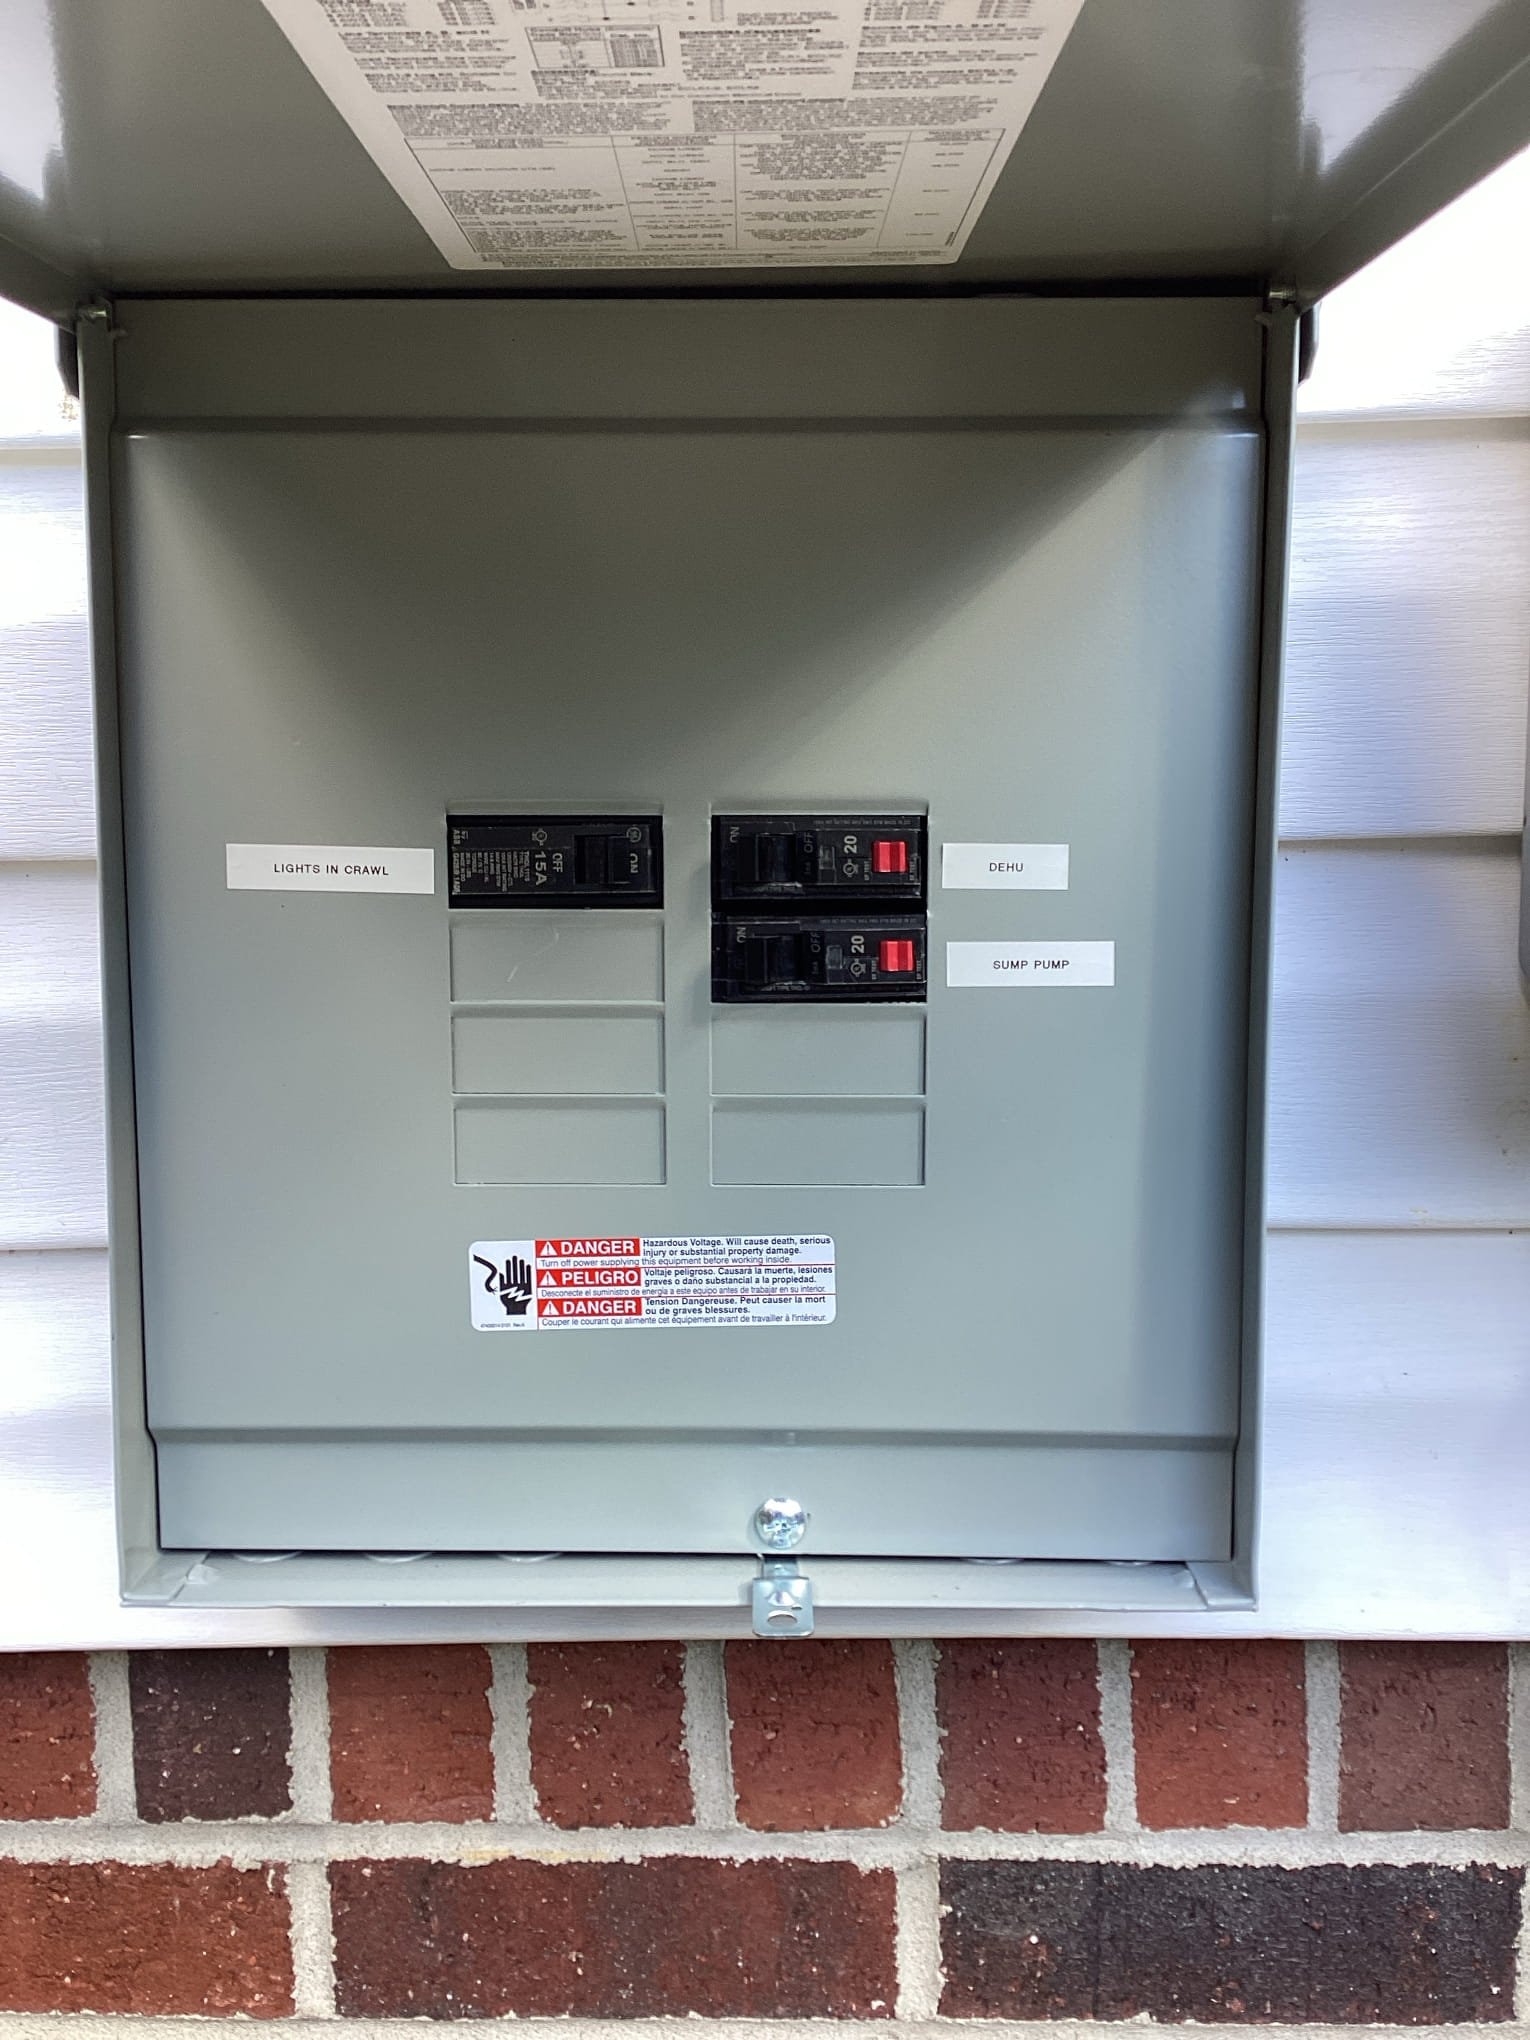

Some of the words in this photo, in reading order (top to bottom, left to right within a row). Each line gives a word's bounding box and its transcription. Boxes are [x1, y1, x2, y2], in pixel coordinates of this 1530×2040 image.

[804, 832, 813, 853] OFF
[844, 835, 858, 854] 20
[534, 851, 547, 886] 15A
[552, 852, 564, 873] OFF
[989, 862, 1024, 872] DEHU
[274, 864, 320, 873] LIGHTS
[326, 865, 339, 874] IN
[344, 865, 389, 875] CRAWL
[851, 935, 865, 954] 20
[993, 960, 1028, 970] SUMP
[1034, 960, 1070, 969] PUMP
[560, 1241, 634, 1254] DANGER
[643, 1239, 688, 1247] Hazardous
[690, 1238, 723, 1248] Voltage.
[772, 1237, 797, 1246] death,
[643, 1249, 666, 1257] injury
[680, 1248, 725, 1256] substantial
[728, 1248, 763, 1256] property
[766, 1247, 802, 1255] damage.
[573, 1260, 598, 1268] power
[600, 1258, 640, 1266] supplying
[658, 1257, 701, 1265] equipment
[732, 1256, 763, 1265] working
[645, 1269, 672, 1277] Voltaje
[675, 1268, 714, 1277] peligroso.
[765, 1267, 795, 1275] muerte,
[798, 1266, 832, 1274] lesiones
[562, 1271, 638, 1285] PELIGRO
[645, 1279, 672, 1287] graves
[706, 1276, 752, 1284] substancial
[772, 1275, 816, 1284] propiedad.
[542, 1289, 583, 1297] Desconecte
[593, 1288, 629, 1296] suministro
[719, 1286, 738, 1294] antes
[751, 1286, 777, 1294] trabajar
[563, 1300, 636, 1314] DANGER
[682, 1297, 737, 1306] Dangereuse.
[740, 1296, 760, 1304] Peut
[762, 1296, 792, 1304] causer
[705, 1306, 750, 1314] blessures.
[542, 1318, 570, 1326] Couper
[611, 1317, 622, 1326] qui
[624, 1316, 655, 1324] alimente
[658, 1316, 670, 1324] cet
[752, 1314, 783, 1322] travailler
